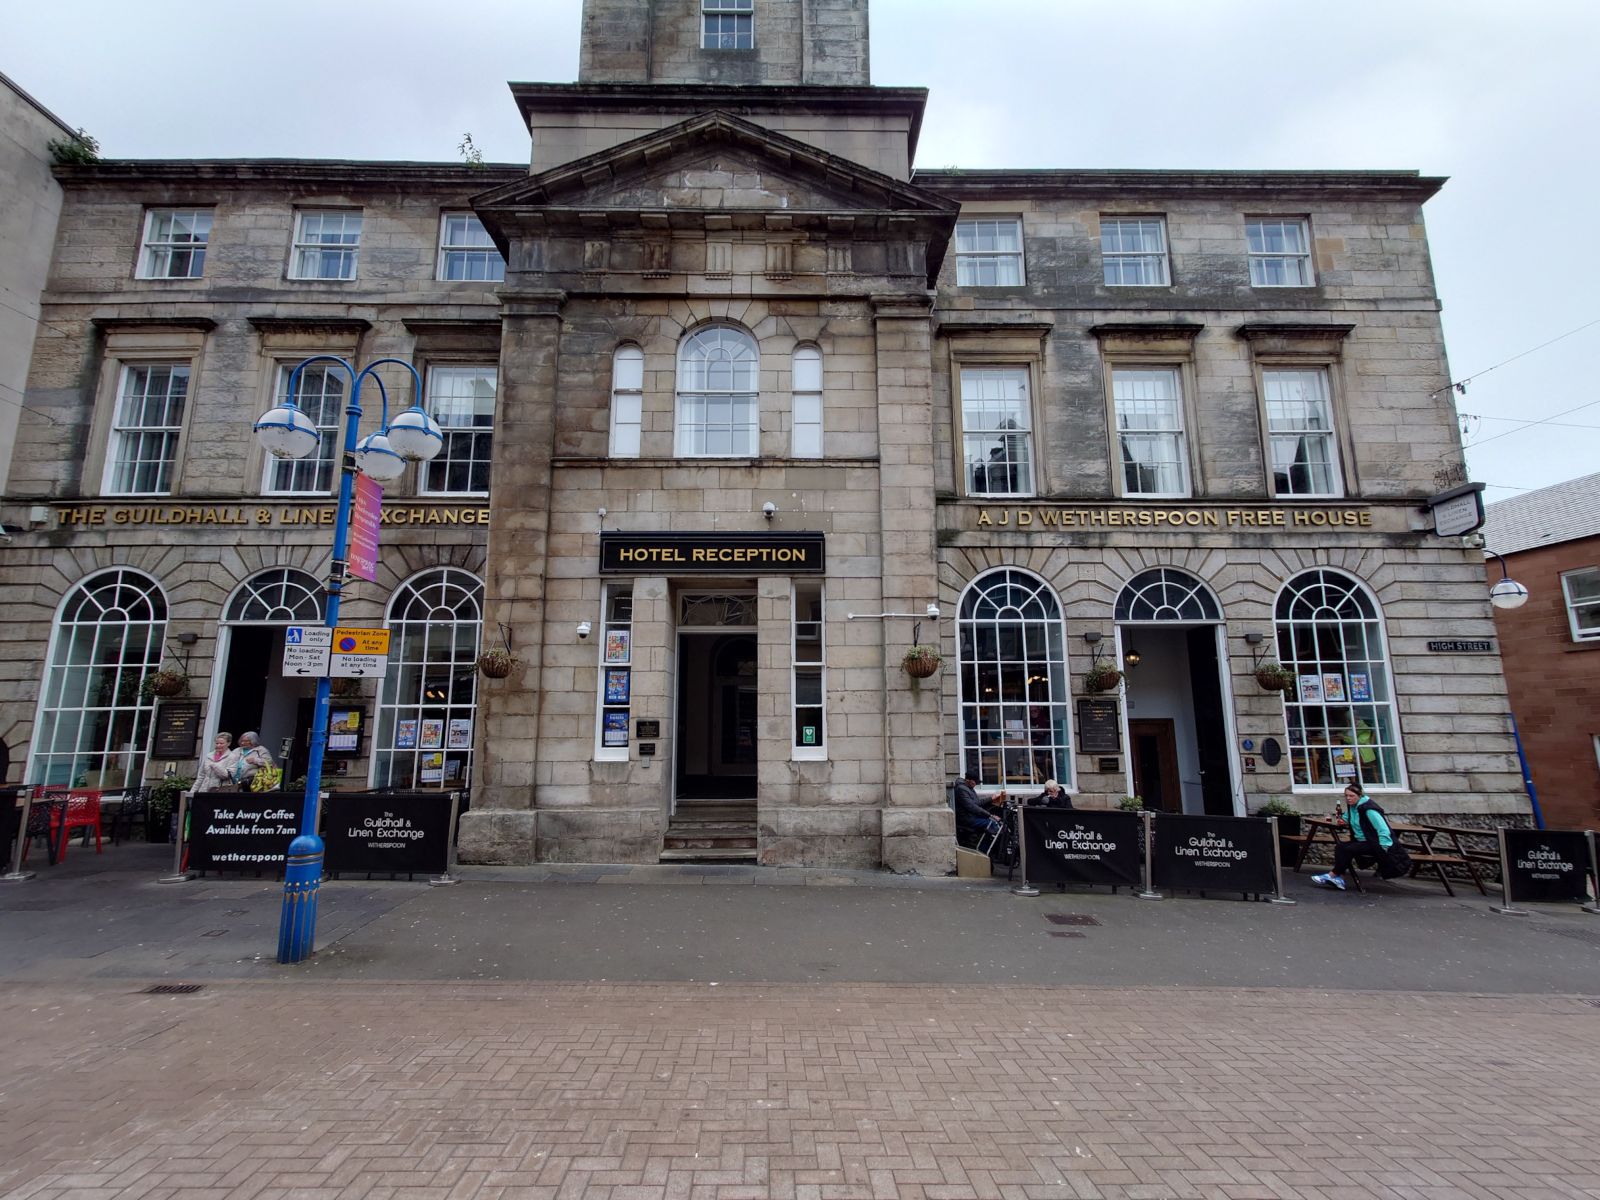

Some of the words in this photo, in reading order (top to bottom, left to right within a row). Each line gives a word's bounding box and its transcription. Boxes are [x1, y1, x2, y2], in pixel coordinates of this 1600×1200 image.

[59, 508, 106, 524] THE
[112, 508, 248, 524] GUILDHALL
[255, 508, 270, 524] &
[378, 508, 490, 524] XCHANGE
[978, 510, 992, 525] A
[998, 510, 1009, 525] J
[1017, 510, 1033, 525] D
[1039, 510, 1219, 526] WETHERSPOON
[1226, 510, 1286, 526] FREE
[1293, 510, 1372, 526] HOUSE
[619, 548, 686, 562] HOTEL
[692, 548, 806, 562] RECEPTION
[1431, 642, 1454, 650] HIGH
[1456, 642, 1488, 650] STREET
[213, 809, 234, 820] Take
[235, 809, 262, 823] Away
[263, 809, 295, 820] Coffee
[364, 818, 404, 828] Guildhall
[405, 820, 412, 828] &
[205, 824, 250, 835] Available
[251, 824, 275, 835] from
[276, 824, 297, 835] 7am
[348, 828, 373, 838] Linen
[376, 828, 425, 840] Exchange
[1057, 830, 1095, 840] Guildhall
[1045, 840, 1068, 849] Linen
[1072, 840, 1116, 853] Exchange
[1188, 837, 1226, 848] Guildhall
[212, 853, 285, 863] wetherspoon
[1175, 846, 1200, 856] Linen
[1202, 847, 1248, 860] Exchange
[1527, 850, 1556, 860] Guildhall
[1517, 859, 1536, 869] Linen
[1537, 860, 1574, 872] Exchange
